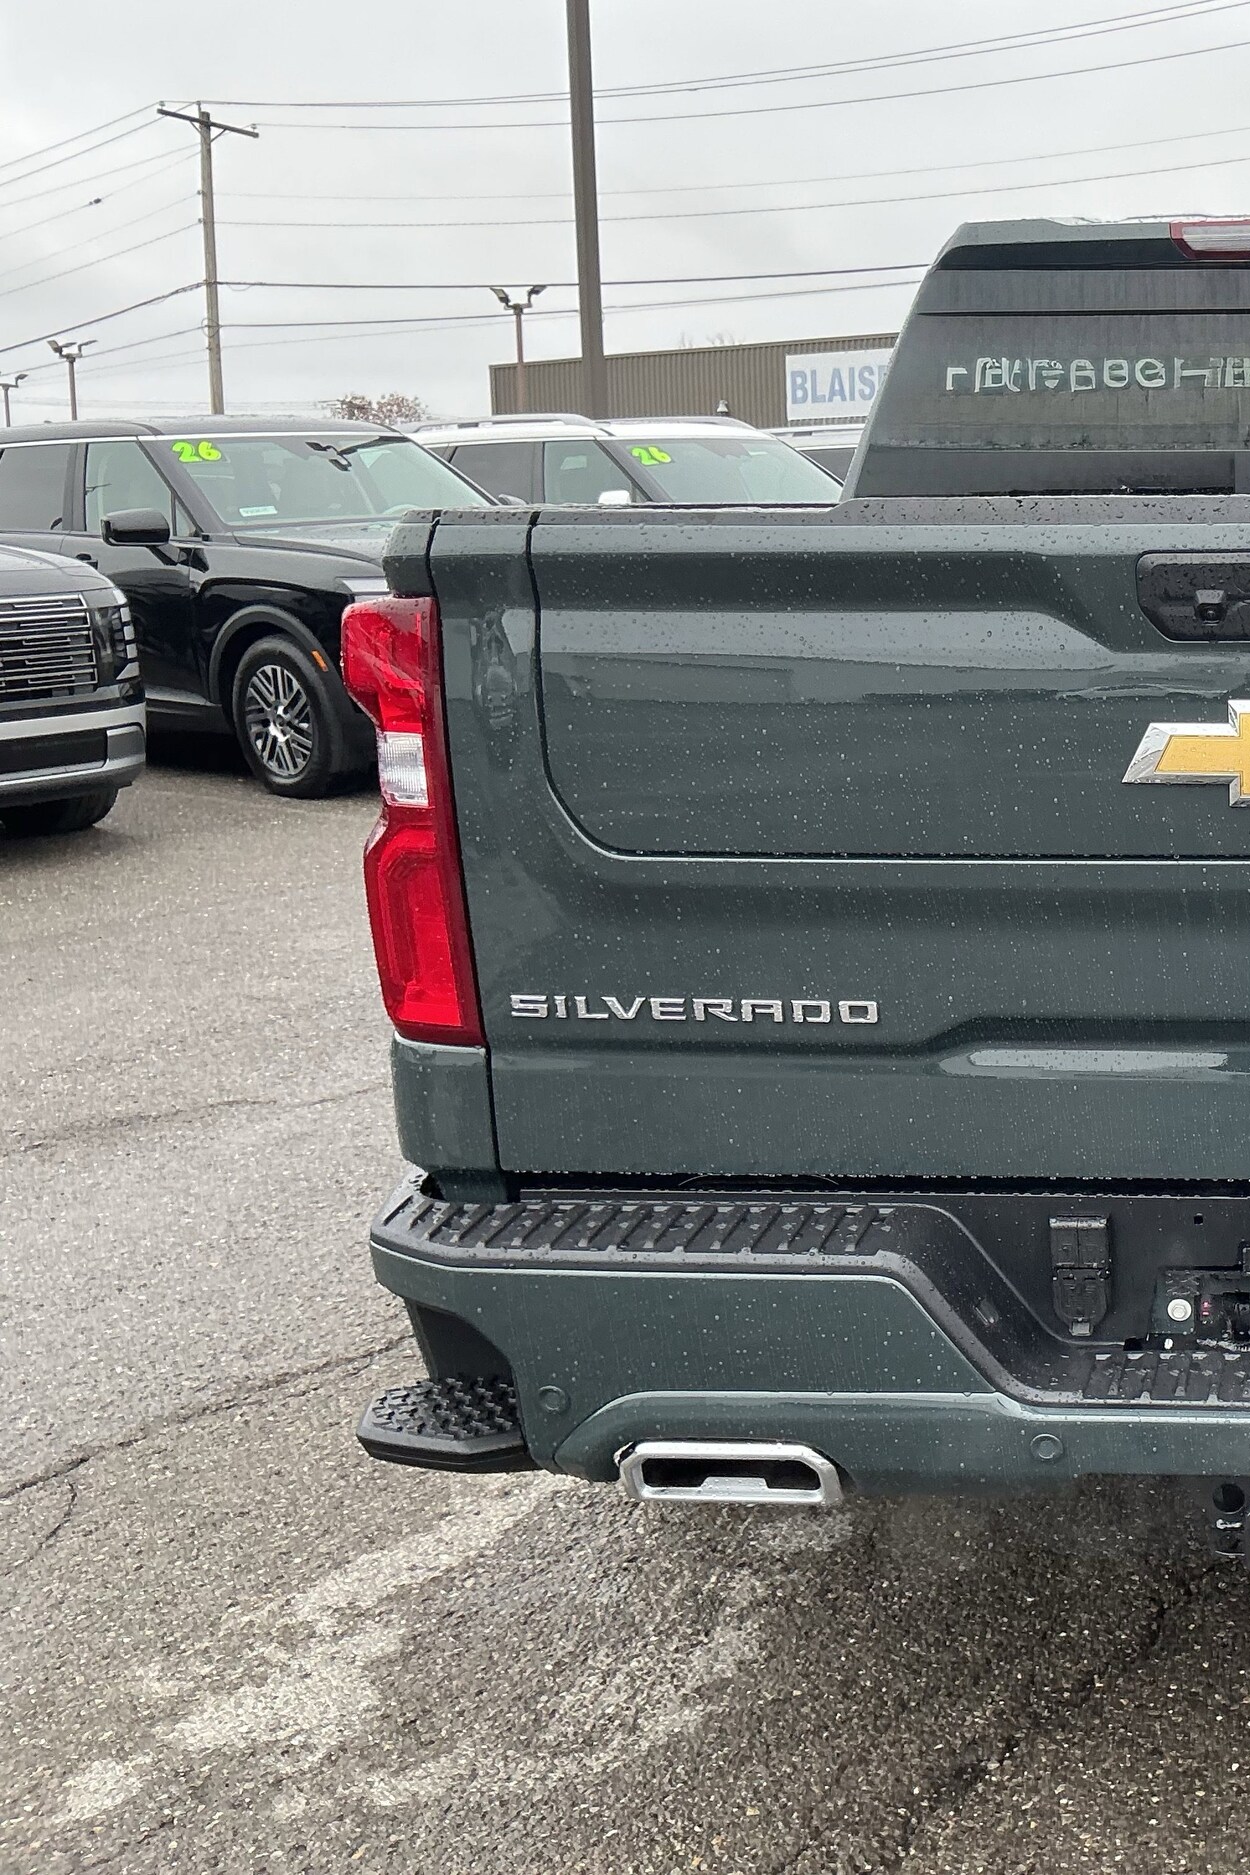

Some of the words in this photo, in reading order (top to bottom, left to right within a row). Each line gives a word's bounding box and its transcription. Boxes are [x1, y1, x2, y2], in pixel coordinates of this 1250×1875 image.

[172, 440, 222, 463] 26
[631, 446, 672, 466] 26
[509, 994, 880, 1025] SILVERADO
